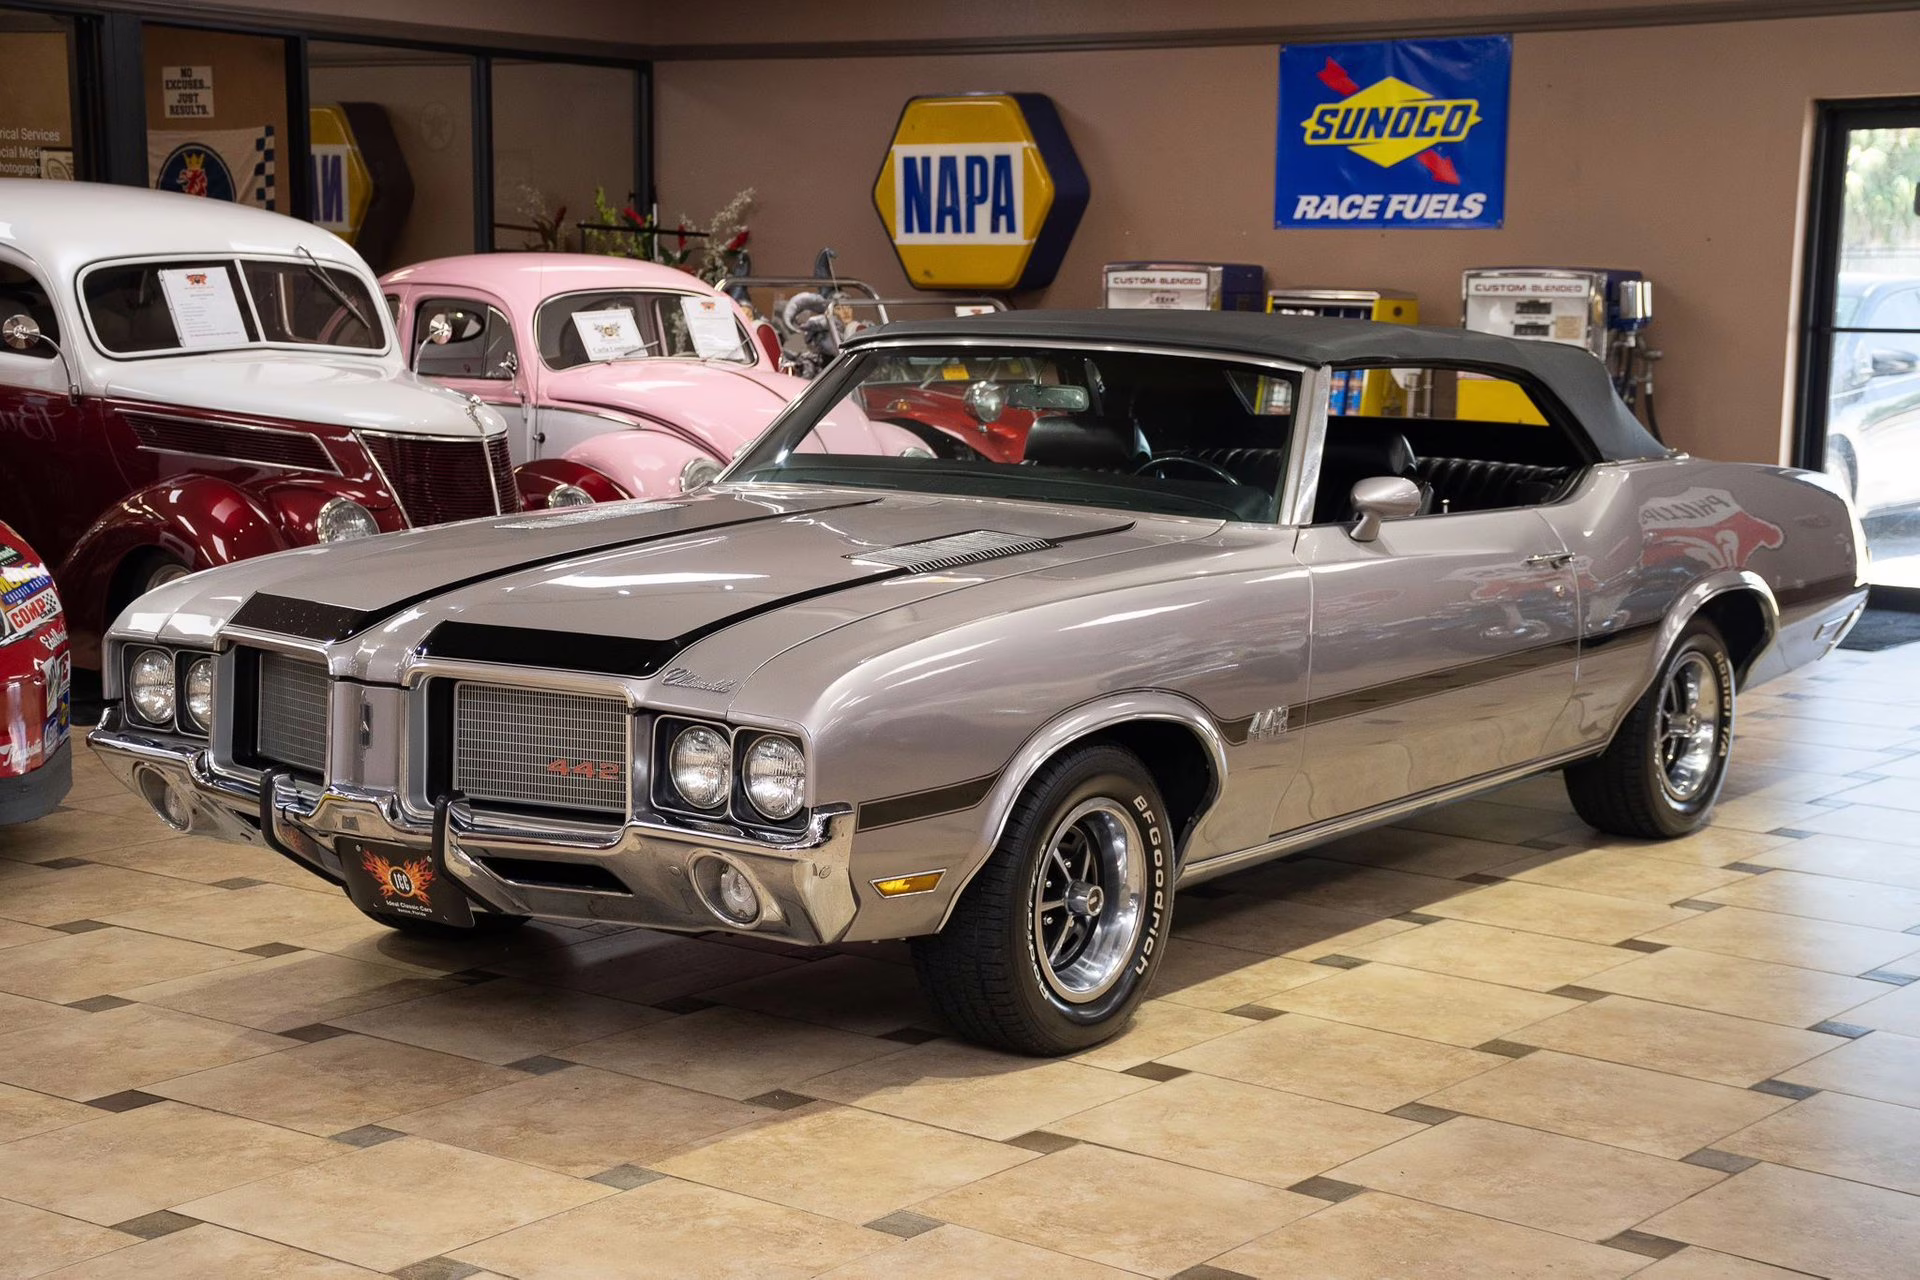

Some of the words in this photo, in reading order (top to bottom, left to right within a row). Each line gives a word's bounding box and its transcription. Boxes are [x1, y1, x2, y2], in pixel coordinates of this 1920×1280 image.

[180, 67, 192, 78] NO
[177, 92, 199, 104] JUST
[1310, 104, 1473, 140] SUNOCO
[20, 127, 60, 142] Services
[0, 145, 17, 158] cial
[903, 154, 1016, 234] NAPA
[1293, 193, 1384, 221] RACE
[1384, 192, 1488, 220] FUELS
[1113, 276, 1156, 285] CUSTOM
[1160, 277, 1202, 286] BLENDED
[1475, 283, 1527, 293] CUSTOM
[1532, 283, 1583, 293] BLENDED
[10, 598, 46, 629] COMP
[39, 606, 57, 619] CAMS
[547, 758, 619, 780] 442
[393, 873, 411, 891] ICC
[385, 899, 399, 908] Ideal
[399, 902, 419, 911] Classic
[419, 905, 433, 913] Cars
